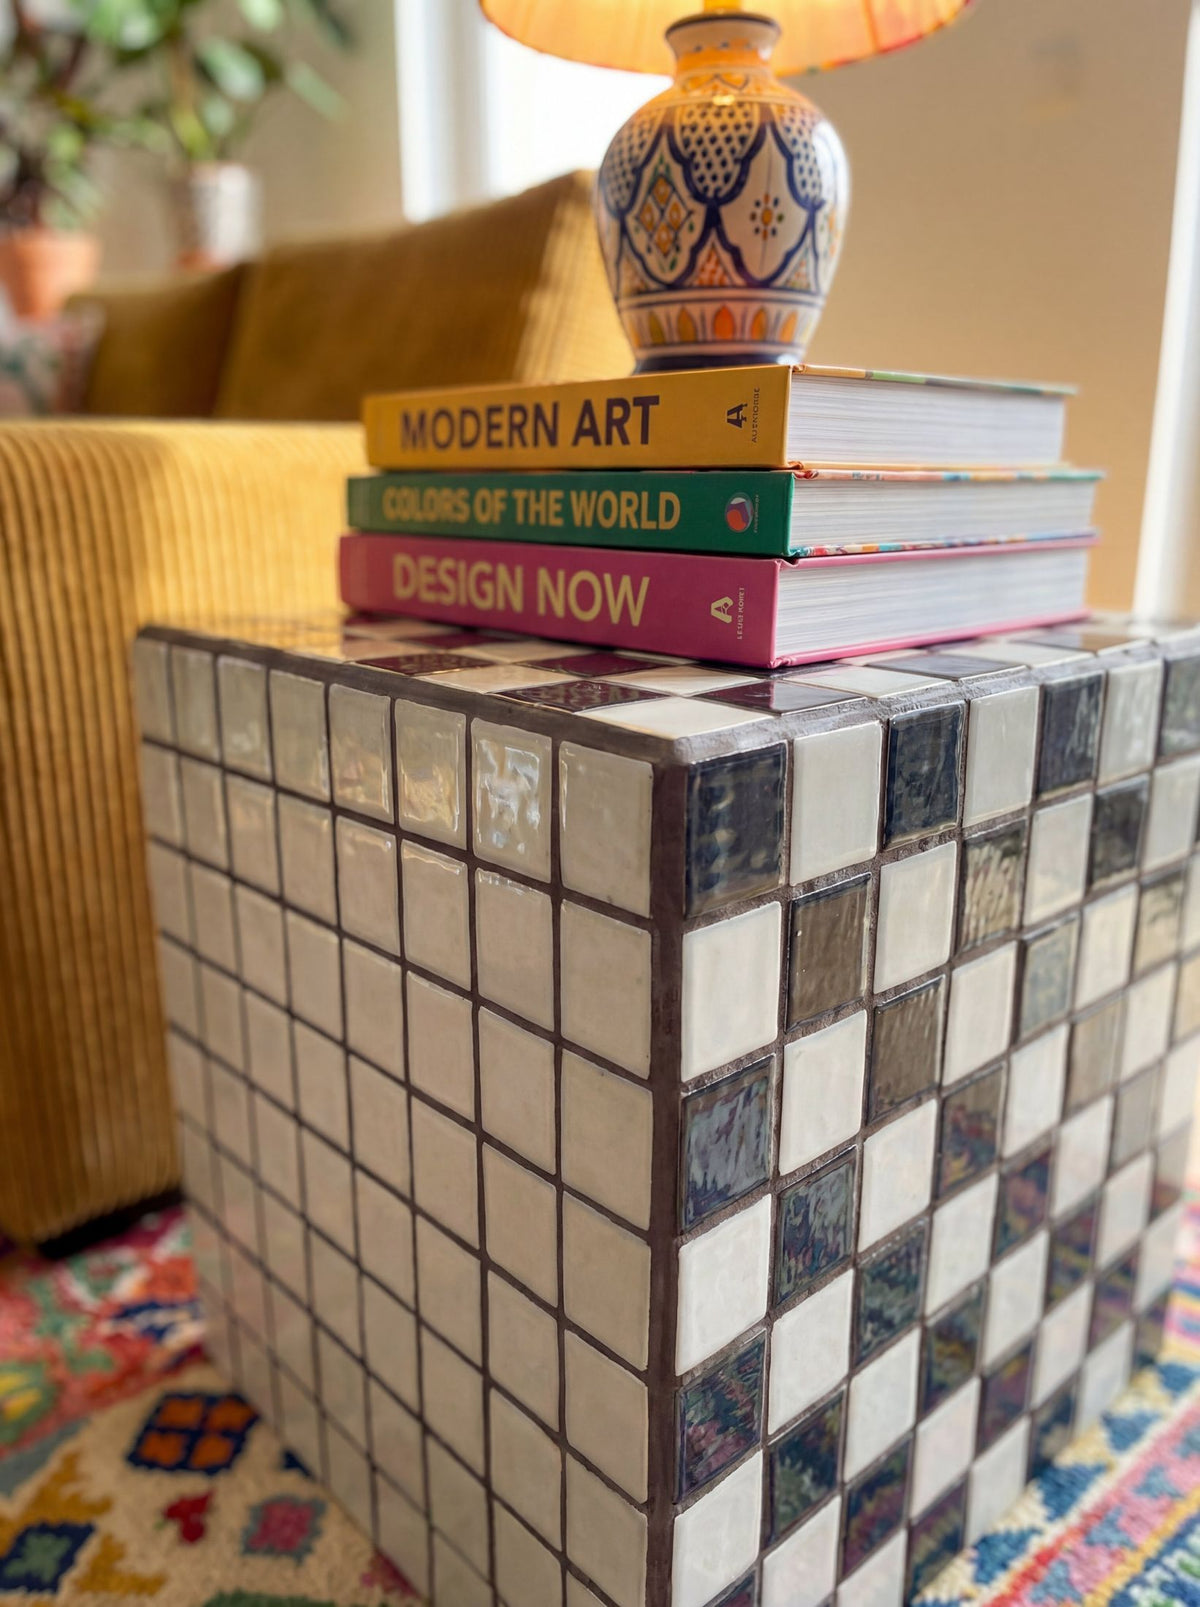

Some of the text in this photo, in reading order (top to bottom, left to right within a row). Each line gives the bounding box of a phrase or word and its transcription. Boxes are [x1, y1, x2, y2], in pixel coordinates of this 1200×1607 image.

[401, 395, 660, 450] MODERN ART
[382, 487, 681, 530] COLORS OF THE WORLD
[392, 552, 651, 627] DESIGN NOW
